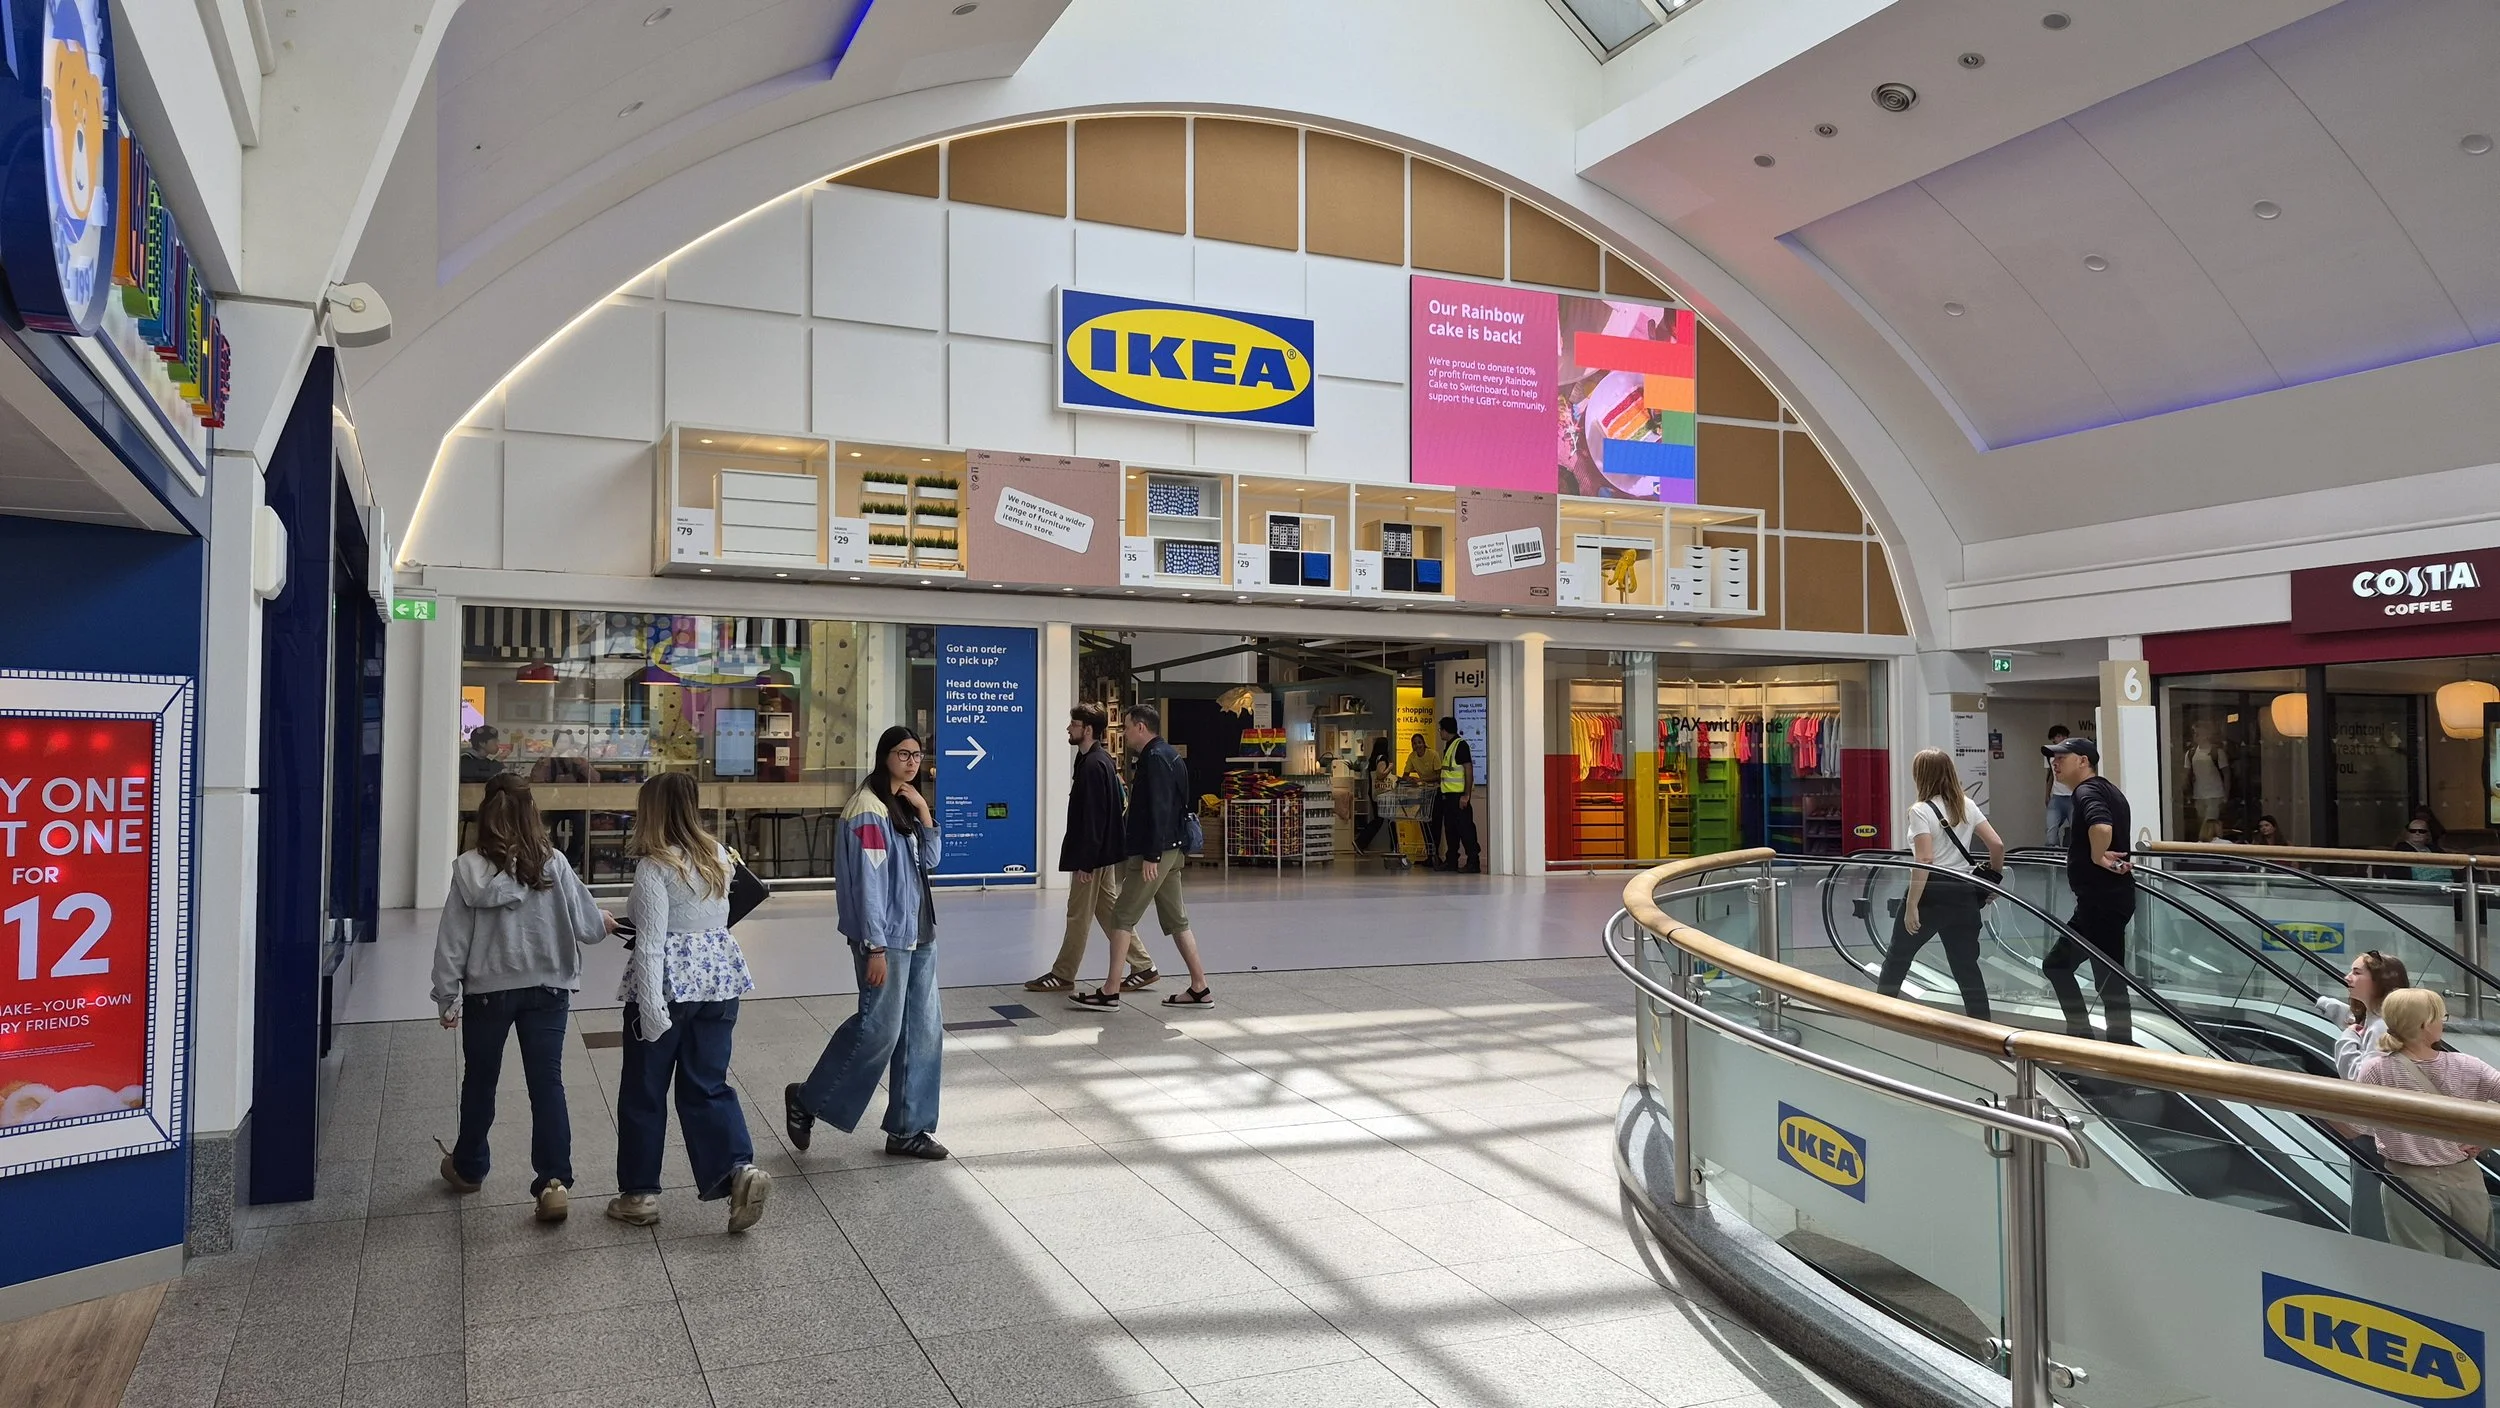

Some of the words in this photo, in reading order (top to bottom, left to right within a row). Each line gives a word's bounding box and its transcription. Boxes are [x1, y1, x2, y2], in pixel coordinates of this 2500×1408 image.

[1429, 299, 1458, 317] Our
[1461, 303, 1525, 325] Rainbow
[1428, 321, 1464, 338] cake
[1467, 324, 1480, 340] is
[1483, 326, 1522, 345] back!
[1091, 328, 1296, 391] IKEA
[1428, 355, 1451, 367] We're
[1452, 360, 1476, 370] proud
[1477, 362, 1486, 371] to
[1487, 363, 1515, 374] donate
[1515, 365, 1536, 376] 100%
[1428, 367, 1438, 377] of
[1439, 369, 1461, 380] profit
[1462, 371, 1481, 381] from
[1482, 375, 1504, 385] every
[1505, 375, 1538, 388] Rainbow
[1428, 379, 1449, 389] Cake
[1450, 381, 1458, 390] to
[1460, 382, 1510, 397] Switchboard,
[1511, 388, 1520, 396] to
[1520, 388, 1538, 400] help
[1428, 392, 1460, 403] support
[1461, 394, 1475, 404] the
[1476, 395, 1501, 406] LGBT+
[1502, 399, 1547, 413] community.
[1004, 503, 1027, 516] range
[1037, 515, 1071, 533] furniture
[1008, 494, 1020, 504] We
[1020, 499, 1037, 510] now
[1037, 506, 1058, 518] stock
[1065, 516, 1087, 528] wider
[1002, 512, 1024, 526] items
[1025, 520, 1033, 529] in
[1034, 524, 1055, 537] store.
[834, 535, 849, 545] £29
[2352, 561, 2481, 597] COSTA
[2384, 600, 2453, 616] COFFEE
[946, 644, 964, 653] Got
[980, 645, 1007, 654] order
[946, 656, 957, 664] to
[959, 656, 979, 666] pick
[982, 657, 999, 667] up?
[946, 680, 971, 688] Head
[973, 680, 1000, 689] down
[1002, 680, 1018, 689] the
[1455, 670, 1484, 688] Hej!
[2124, 667, 2142, 701] 6
[946, 691, 965, 700] lifts
[967, 692, 977, 700] to
[980, 691, 996, 700] the
[998, 692, 1014, 700] red
[1977, 698, 1985, 710] 6
[946, 703, 984, 713] parking
[1402, 706, 1433, 715] shopping
[946, 715, 971, 723] Level
[974, 715, 988, 723] P2.
[1420, 717, 1433, 725] app
[1671, 716, 1701, 731] PAX
[1706, 717, 1739, 732] with
[1745, 716, 1783, 737] pride
[41, 777, 146, 814] ONE
[39, 818, 143, 856] ONE
[12, 866, 59, 885] FOR
[26, 1014, 90, 1032] FRIENDS
[1787, 1122, 1858, 1180] IKEA
[2284, 1303, 2467, 1391] IKEA
